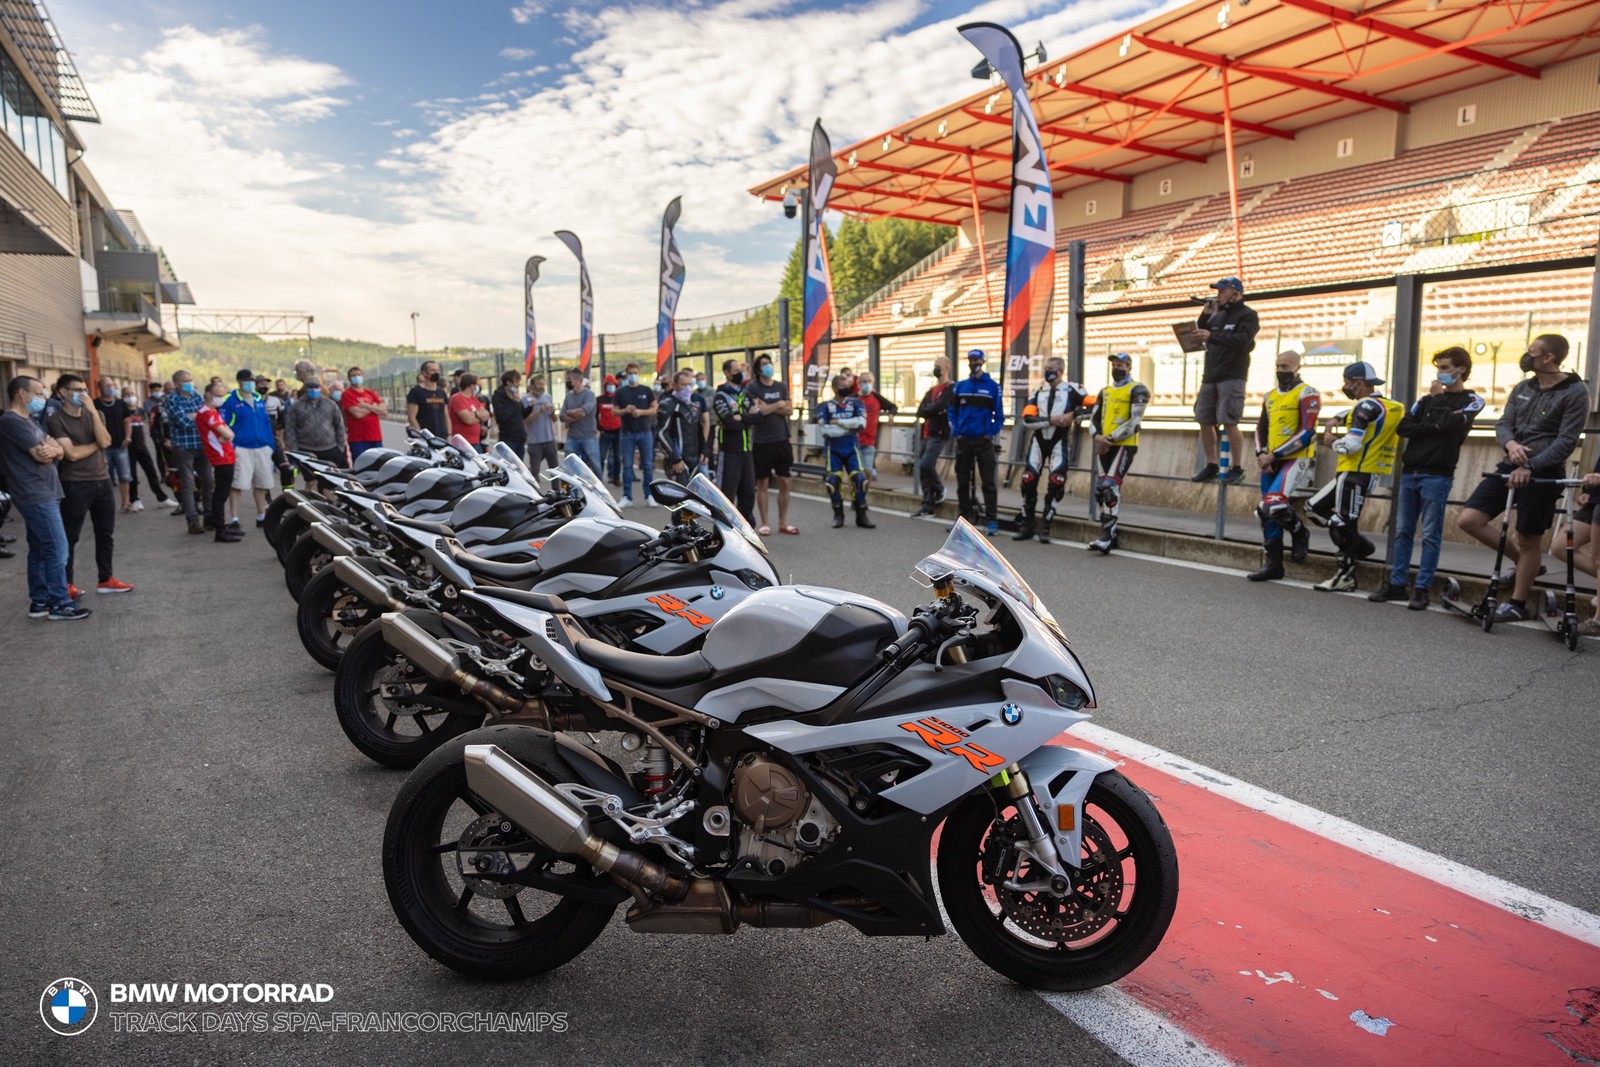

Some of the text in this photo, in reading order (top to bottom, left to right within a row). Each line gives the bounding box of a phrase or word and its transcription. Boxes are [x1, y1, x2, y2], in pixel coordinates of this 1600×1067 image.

[1462, 108, 1471, 123] L
[1243, 165, 1250, 174] H
[1006, 354, 1044, 371] BMC
[928, 715, 970, 738] S1000
[897, 718, 1006, 775] RR
